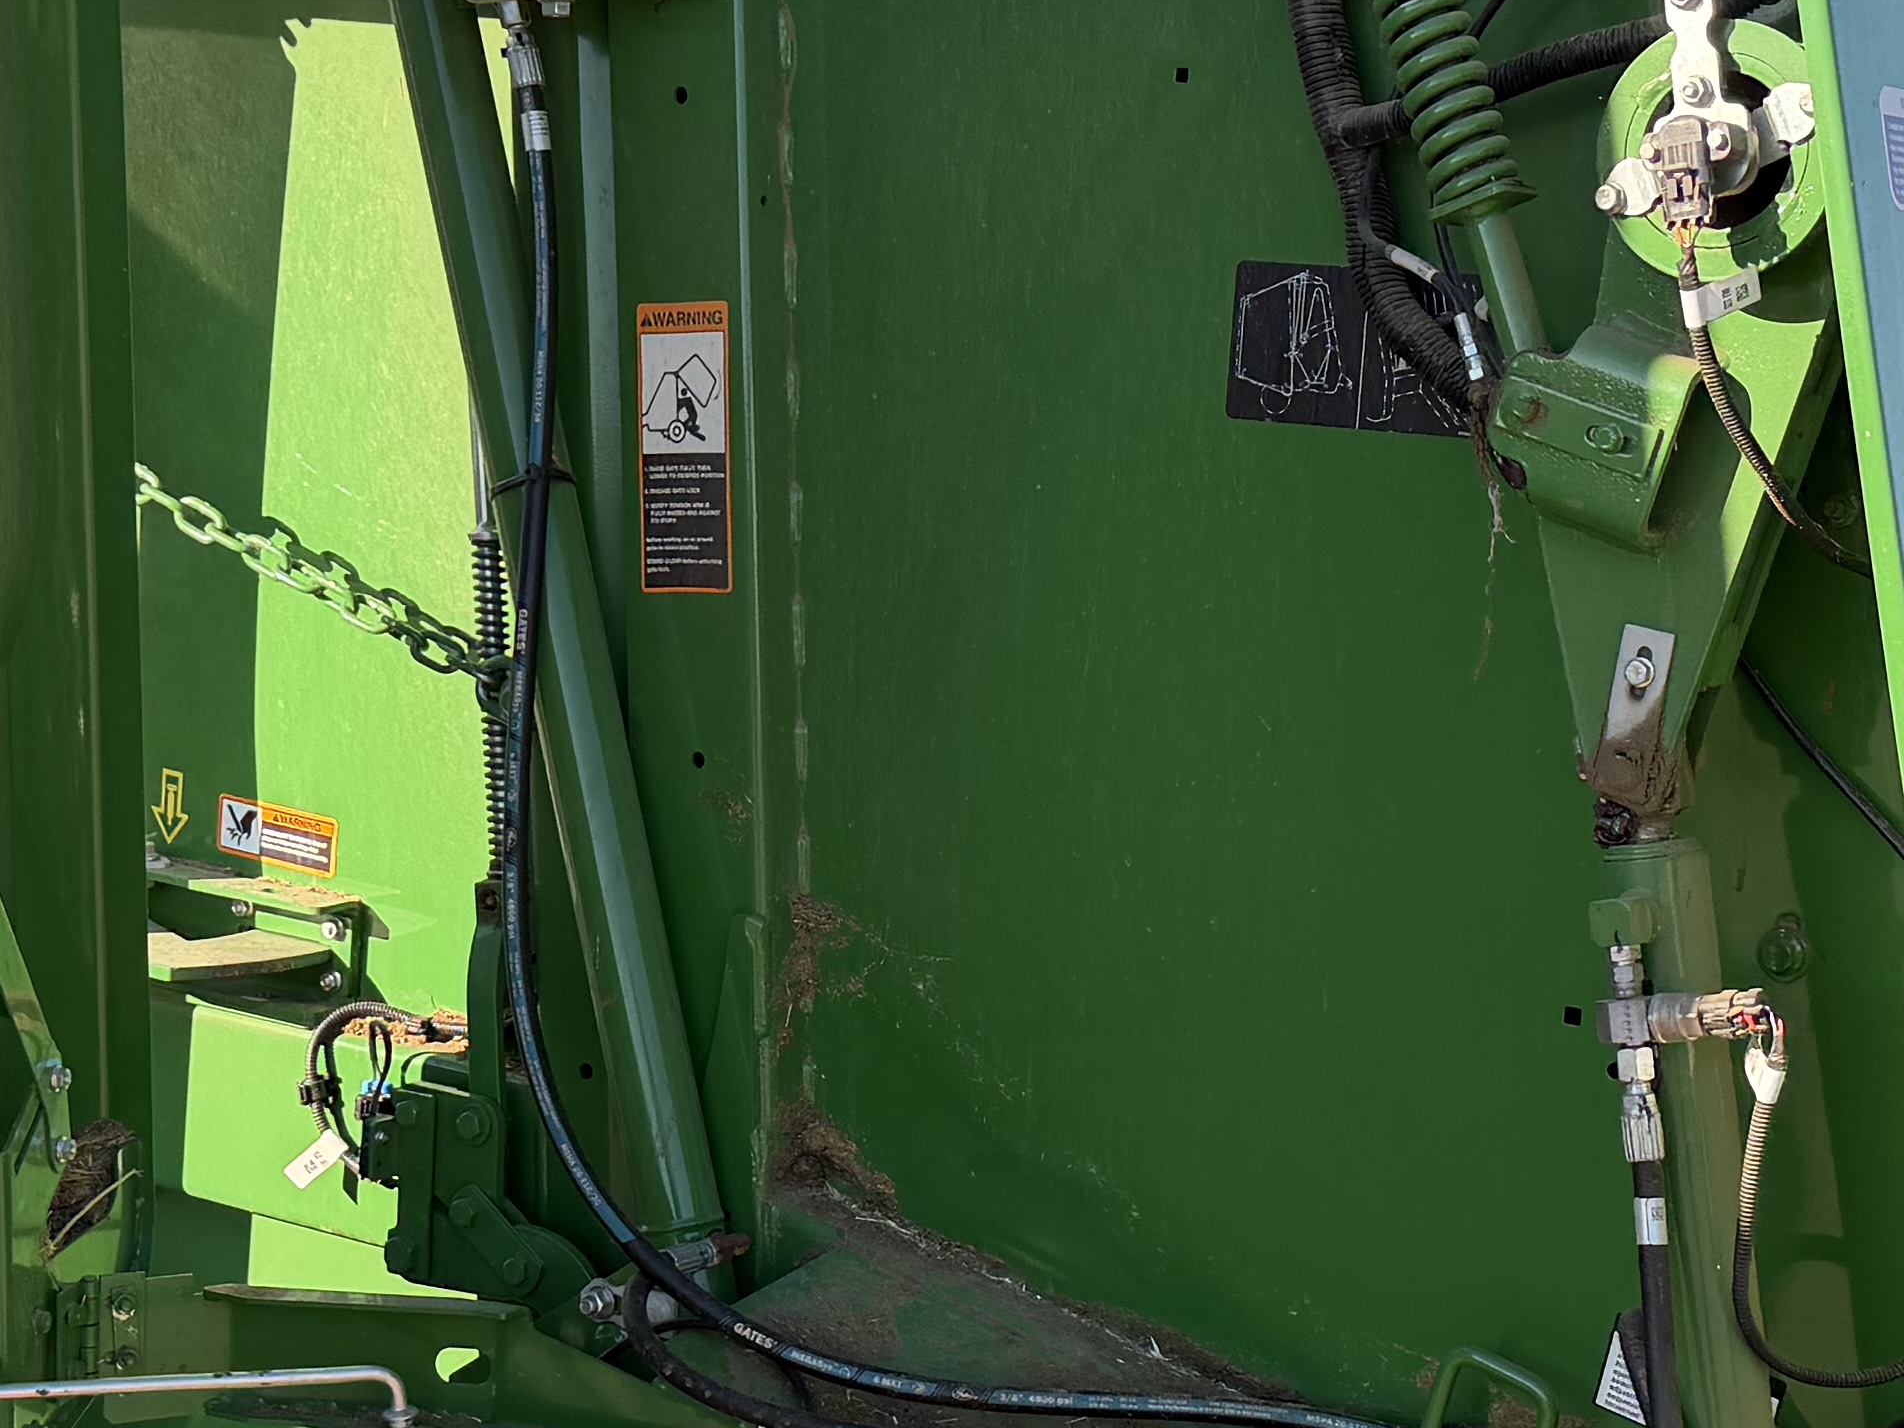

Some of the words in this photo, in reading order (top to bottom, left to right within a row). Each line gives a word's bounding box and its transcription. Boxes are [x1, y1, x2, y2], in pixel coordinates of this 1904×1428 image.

[652, 310, 723, 327] WARNING
[517, 609, 528, 650] GATES
[733, 1322, 773, 1349] GATES
